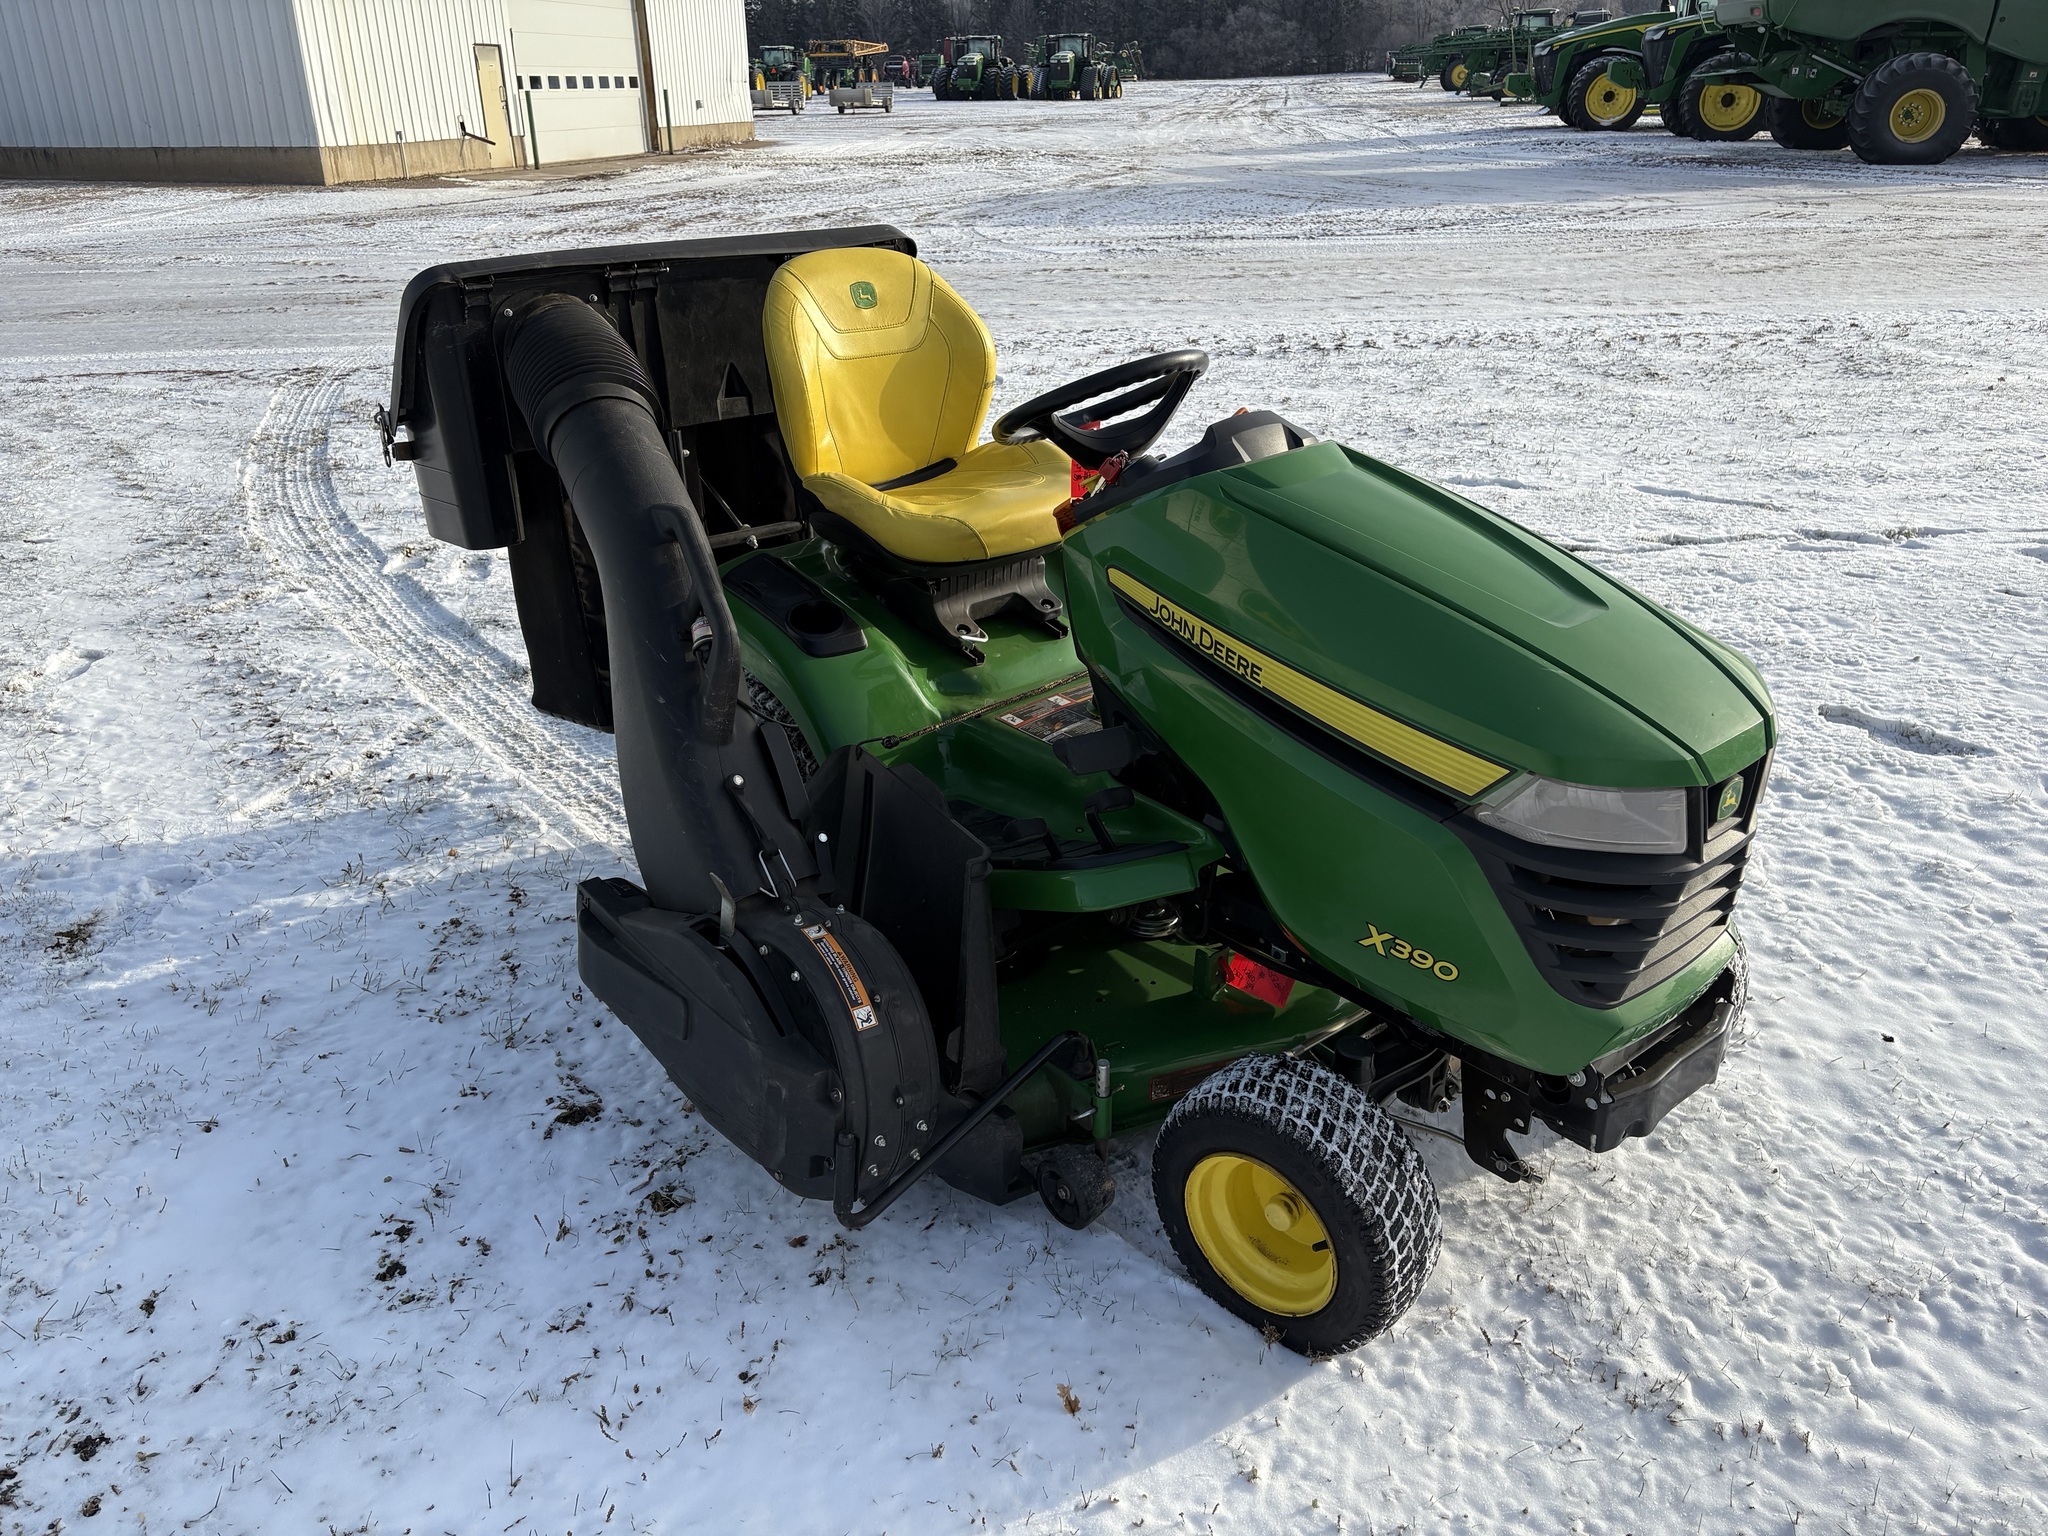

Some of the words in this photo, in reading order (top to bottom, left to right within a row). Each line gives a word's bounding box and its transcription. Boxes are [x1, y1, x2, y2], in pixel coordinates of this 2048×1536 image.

[1149, 596, 1195, 642] JOHN
[1200, 626, 1263, 687] DEERE
[1356, 921, 1460, 982] X390
